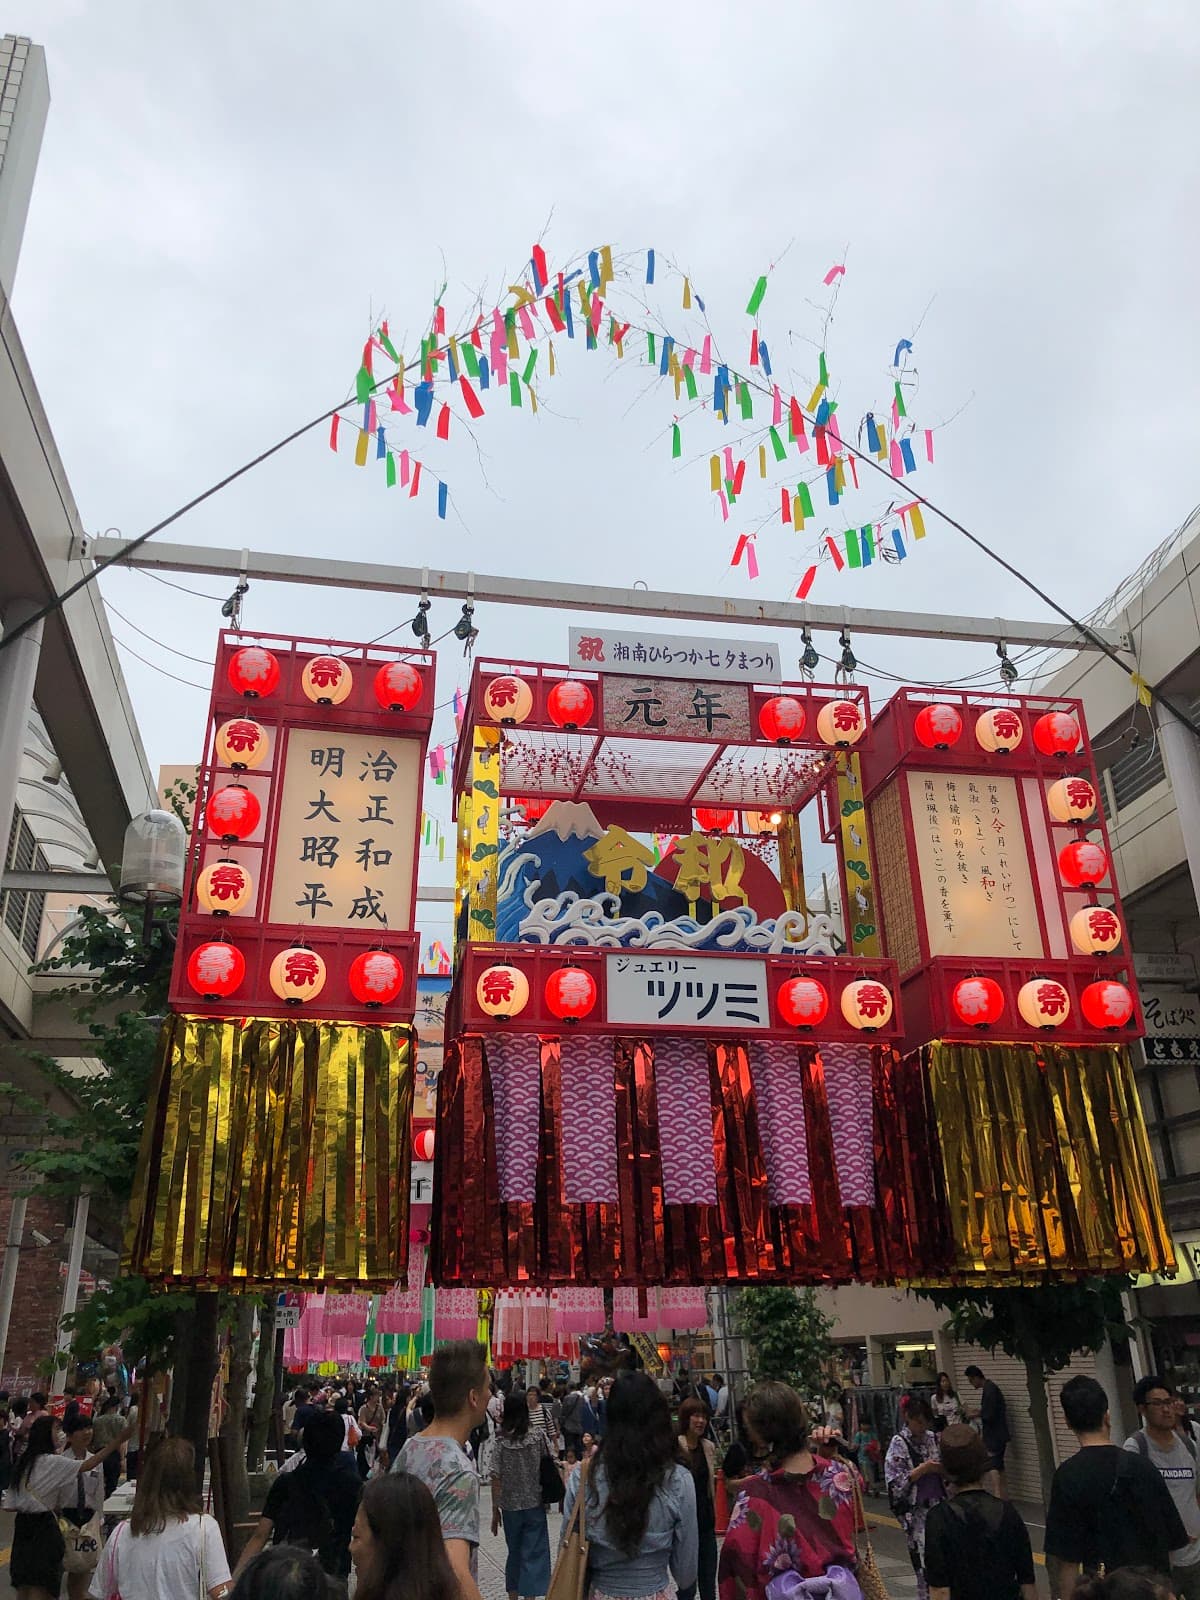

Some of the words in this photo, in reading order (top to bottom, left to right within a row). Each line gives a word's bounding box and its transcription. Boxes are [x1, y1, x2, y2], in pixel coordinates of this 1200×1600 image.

[577, 635, 605, 663] 祝
[613, 642, 775, 673] 湘南ひらつか七夕まつり
[311, 658, 342, 688] 祭
[489, 679, 518, 707] 祭
[622, 687, 732, 732] 元年
[834, 703, 860, 731] 祭
[992, 709, 1020, 739] 祭
[227, 721, 260, 752] 祭
[311, 747, 398, 783] 明治
[305, 790, 393, 825] 大正
[1067, 780, 1093, 809] 祭
[300, 836, 391, 871] 昭和
[210, 866, 244, 900] 祭
[295, 883, 388, 924] 平成
[1089, 911, 1117, 942] 祭
[285, 953, 319, 987] 祭
[615, 957, 697, 975] ジュエリー
[483, 971, 514, 1005] 祭
[647, 981, 760, 1023] ツツミ
[857, 985, 887, 1018] 祭
[1037, 984, 1064, 1016] 祭
[1142, 998, 1197, 1029] そば処
[1159, 1469, 1193, 1478] TANDARD
[74, 1538, 98, 1552] Lee
